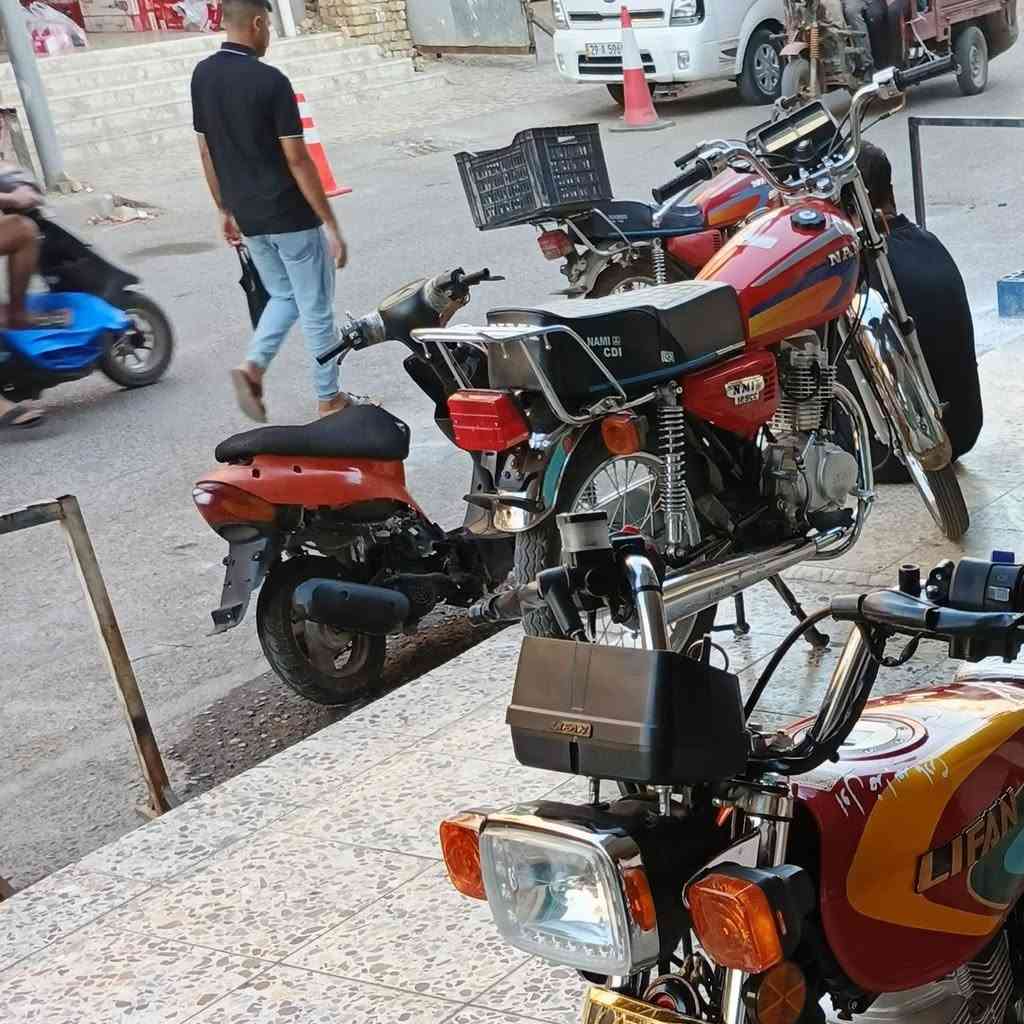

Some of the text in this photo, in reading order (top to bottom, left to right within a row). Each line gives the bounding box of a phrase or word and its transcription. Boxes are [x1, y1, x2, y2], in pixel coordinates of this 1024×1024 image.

[586, 336, 611, 346] NAMI
[603, 347, 622, 358] CDI
[915, 787, 1019, 894] LIFAN
